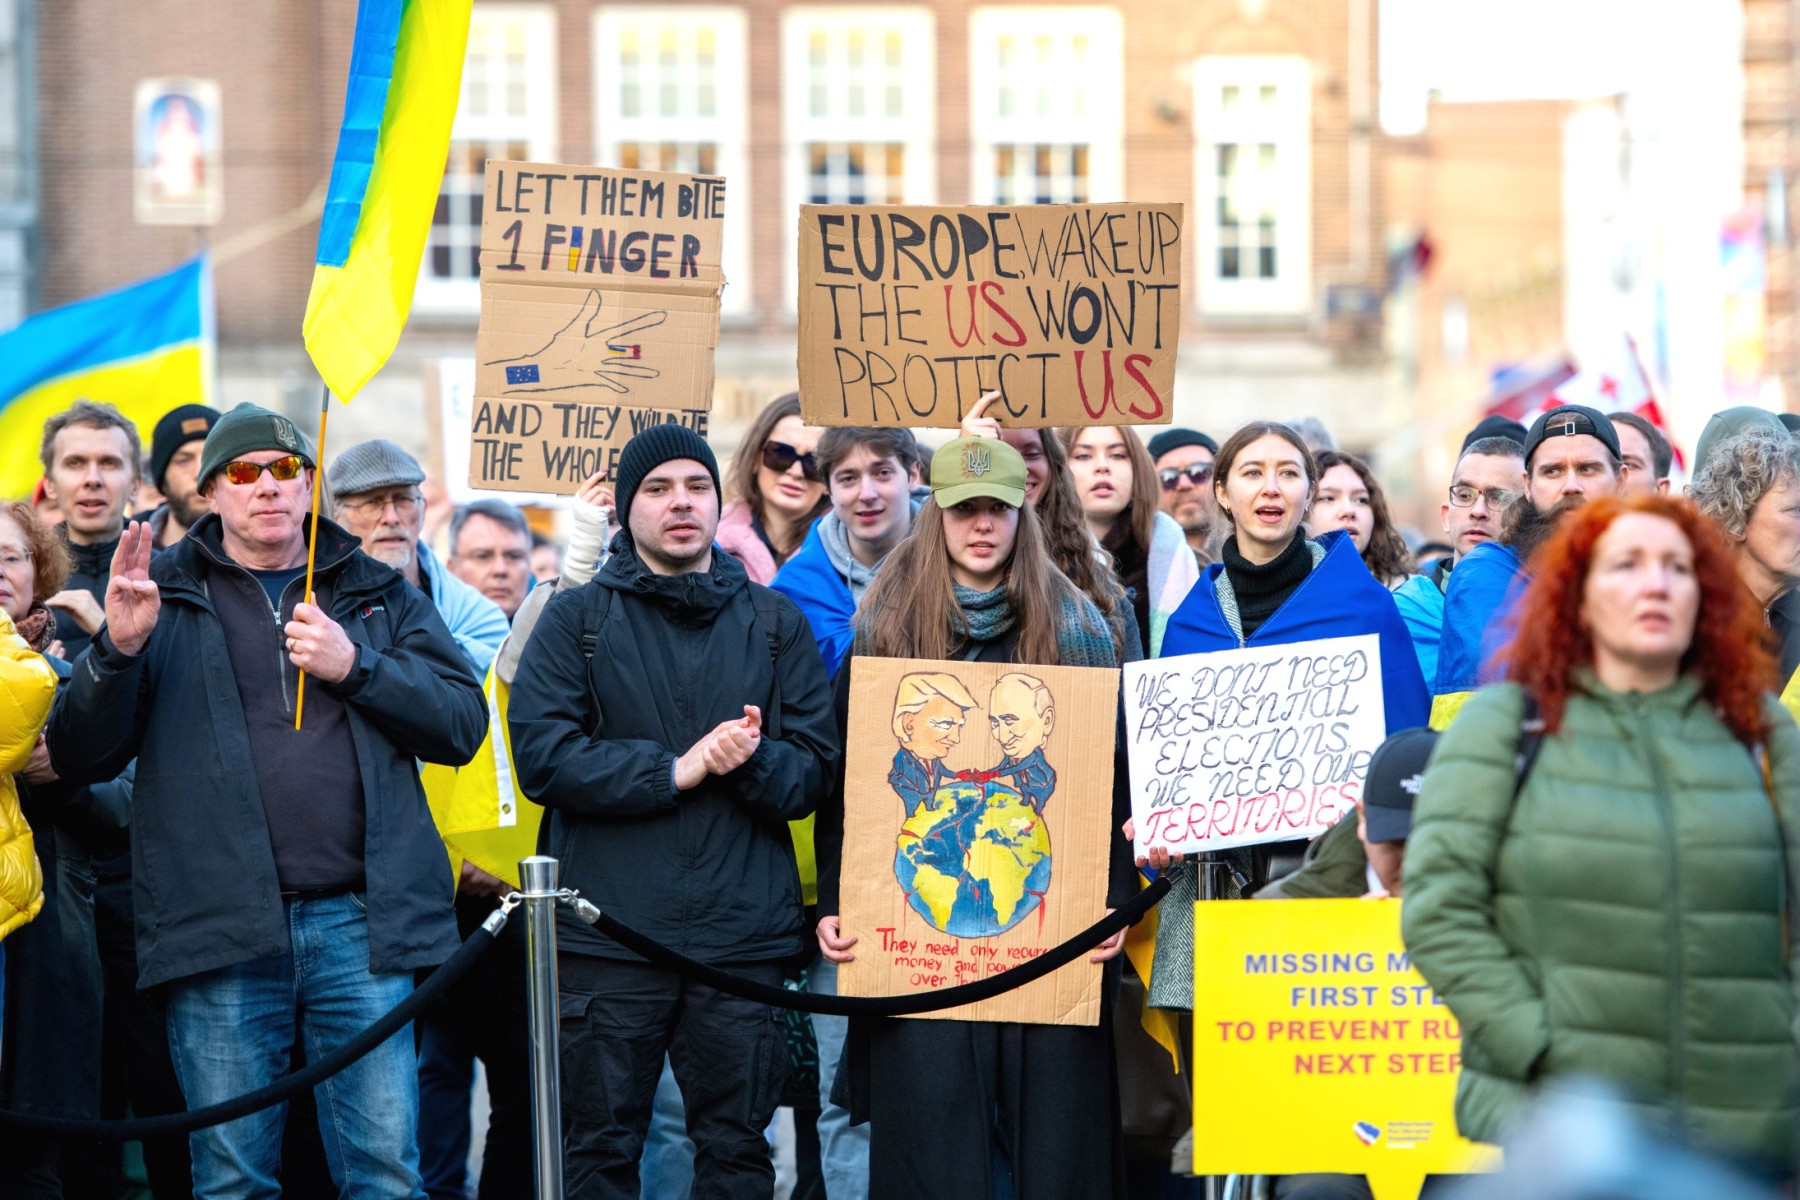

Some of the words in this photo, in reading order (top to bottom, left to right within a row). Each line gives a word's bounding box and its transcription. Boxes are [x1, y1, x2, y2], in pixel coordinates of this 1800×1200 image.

[496, 170, 567, 215] LET
[573, 174, 665, 219] THEM
[678, 177, 726, 220] BITE
[496, 220, 526, 271] 1
[541, 223, 701, 278] FINGER
[817, 212, 1025, 282] EUROPE,
[1015, 209, 1135, 282] WAKE
[1137, 211, 1180, 276] UP
[815, 282, 928, 346] THE
[944, 280, 1028, 348] US
[1026, 279, 1179, 349] WON'T
[833, 346, 1061, 422] PROTECT
[1074, 350, 1164, 420] US
[472, 402, 543, 435] AND
[553, 403, 621, 440] THEY
[474, 439, 523, 482] THE
[542, 440, 620, 484] WHOLE
[1135, 672, 1181, 710] WE
[1288, 650, 1368, 691] NEED
[1136, 684, 1359, 744] PRESIDENTIAL
[1145, 773, 1194, 809] WE
[1209, 758, 1306, 802] NEED
[1312, 750, 1373, 786] OUR
[1143, 782, 1359, 847] TERRITORIES
[875, 927, 918, 957] They
[926, 938, 959, 956] need
[970, 938, 998, 960] only
[894, 955, 942, 972] money
[954, 960, 978, 974] and
[1245, 953, 1375, 974] MISSING
[1291, 986, 1379, 1006] FIRST
[1216, 1021, 1256, 1041] TO
[1267, 1020, 1410, 1041] PREVENT
[1422, 1019, 1462, 1040] RU
[1293, 1054, 1376, 1074] NEXT
